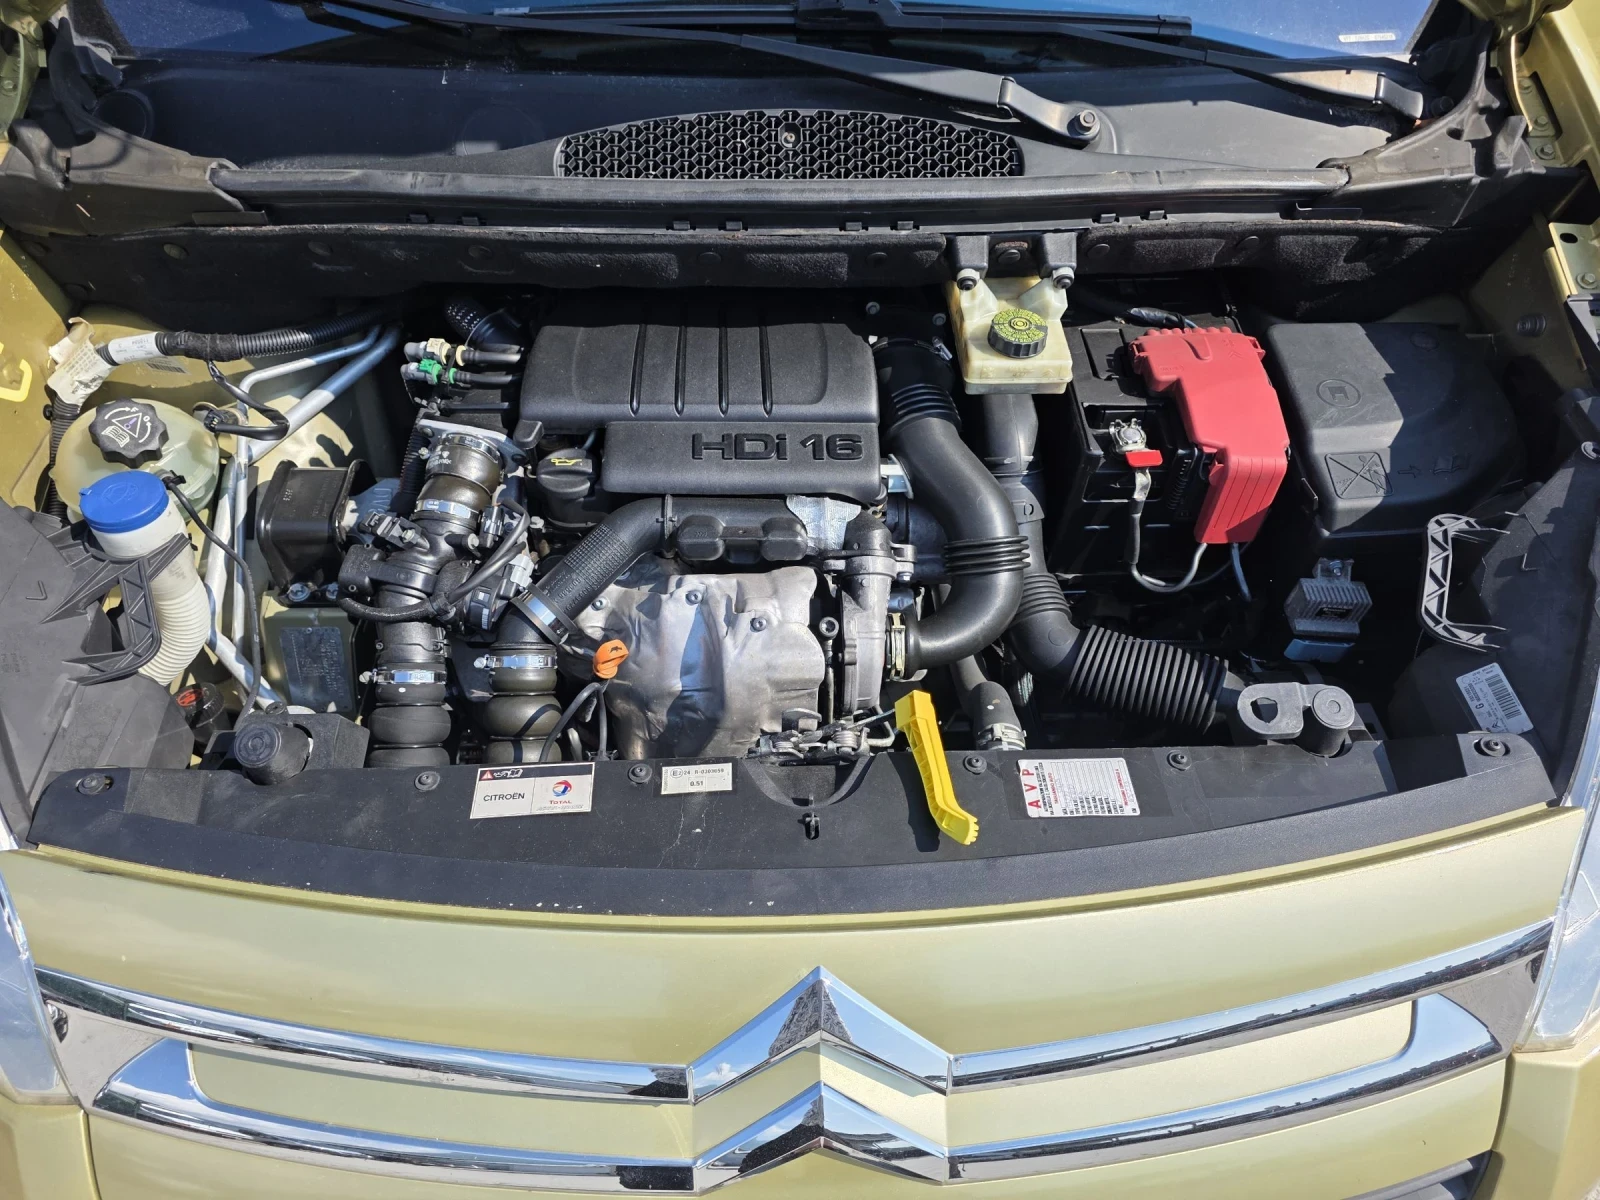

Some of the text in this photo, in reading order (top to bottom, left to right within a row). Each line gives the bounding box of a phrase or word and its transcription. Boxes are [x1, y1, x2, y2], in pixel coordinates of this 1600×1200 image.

[692, 432, 864, 460] HDi 16
[483, 792, 526, 802] CITROËN
